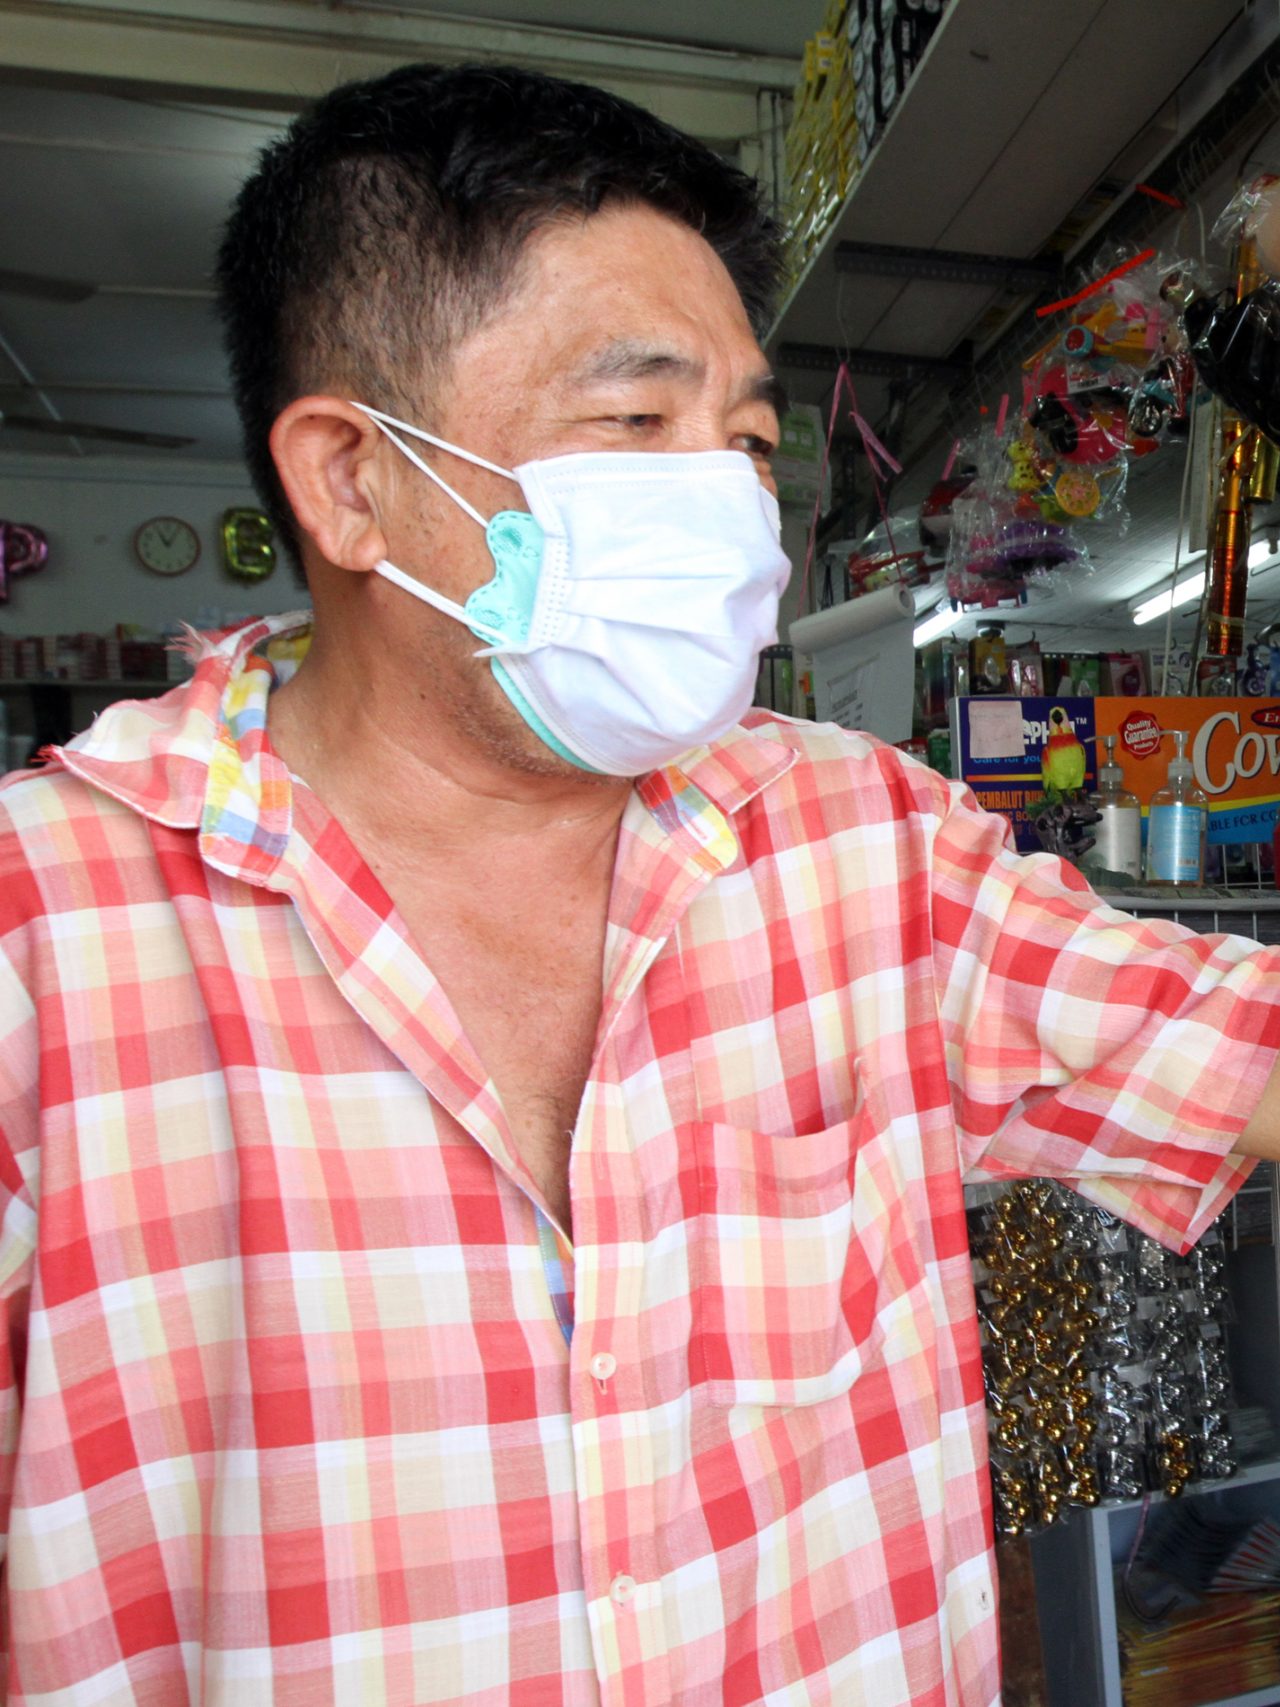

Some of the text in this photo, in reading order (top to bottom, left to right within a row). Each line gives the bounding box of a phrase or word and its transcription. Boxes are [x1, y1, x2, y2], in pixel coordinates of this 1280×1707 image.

[1126, 720, 1151, 730] Quality
[1124, 727, 1158, 744] Guarantee
[976, 790, 1023, 809] PEMBALUT
[1234, 813, 1257, 827] FOR
